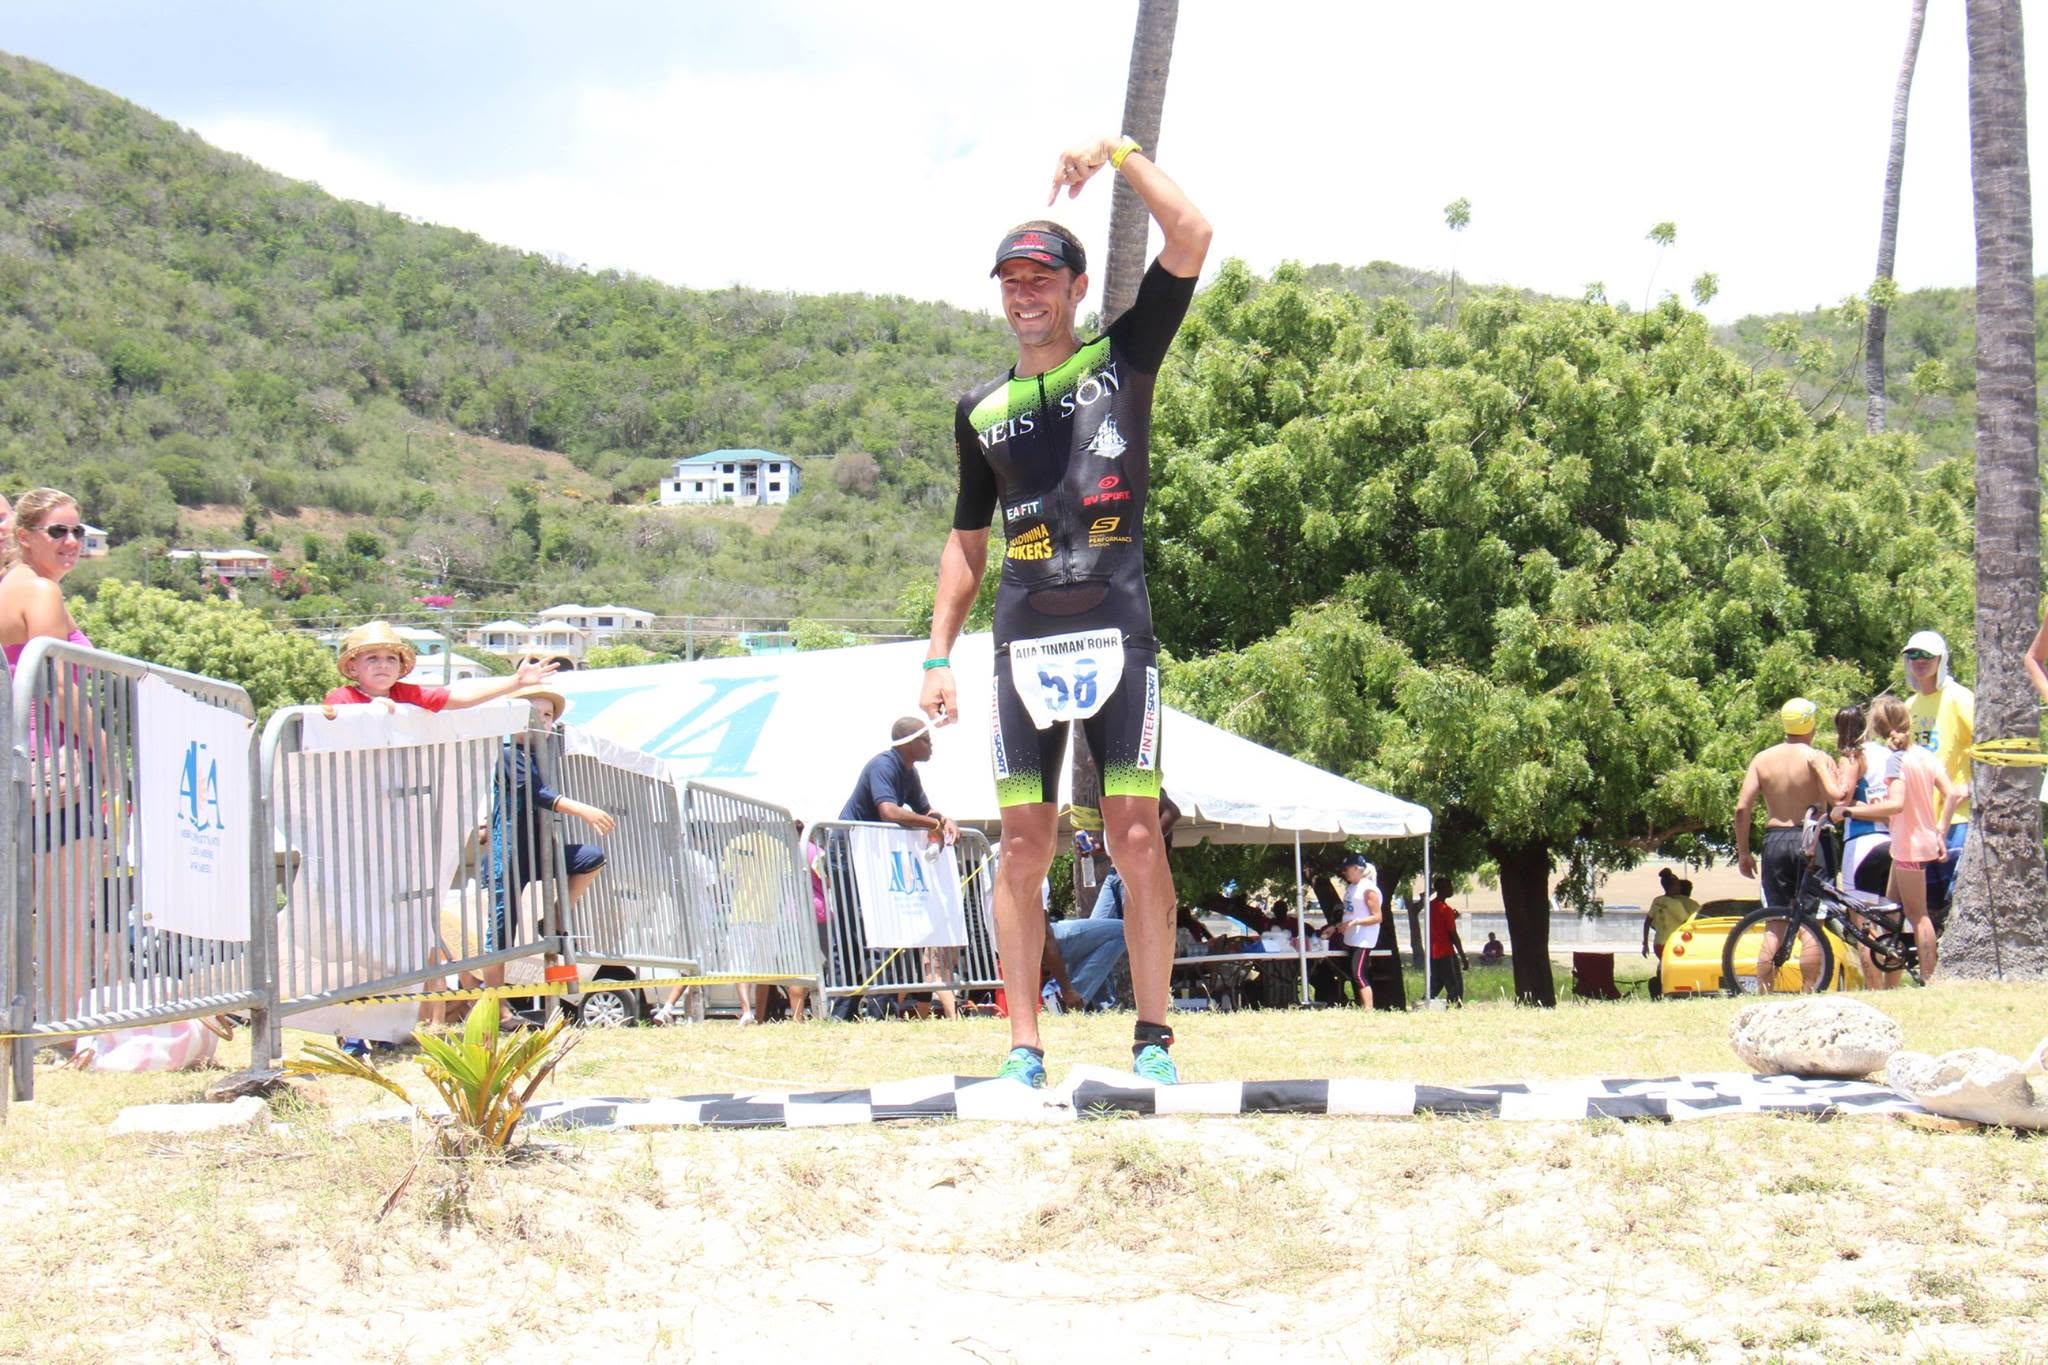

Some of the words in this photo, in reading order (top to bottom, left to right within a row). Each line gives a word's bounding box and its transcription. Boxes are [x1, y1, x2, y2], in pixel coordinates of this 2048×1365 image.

[1006, 538, 1053, 560] BIKERS
[1087, 636, 1118, 649] ROHR
[1141, 672, 1156, 752] INTERSPORT
